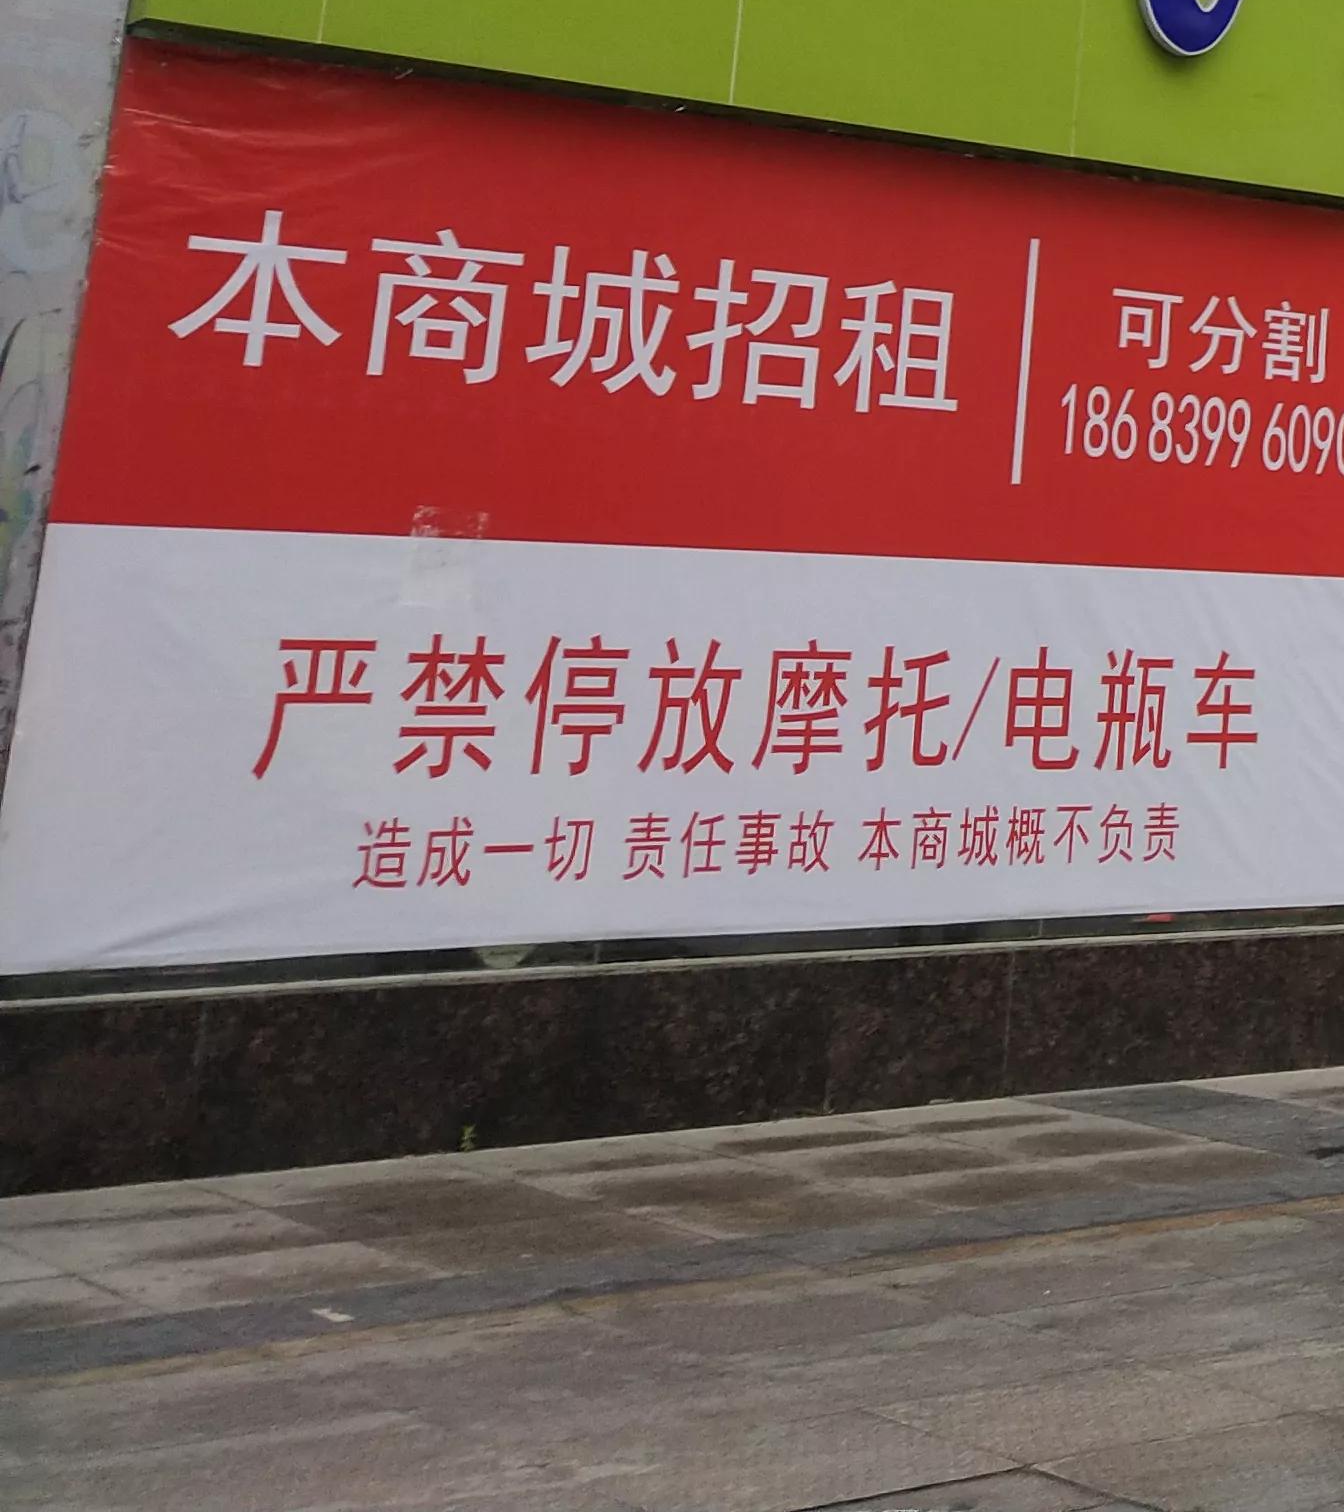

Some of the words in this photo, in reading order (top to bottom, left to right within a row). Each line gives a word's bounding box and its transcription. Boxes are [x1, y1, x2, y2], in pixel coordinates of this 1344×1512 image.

[168, 208, 961, 418] 本商城招租
[1111, 284, 1332, 386] 可分割
[250, 633, 1261, 782] 严禁停放摩托/电瓶车
[352, 816, 597, 893] 造成一切
[622, 808, 834, 880] 责任事故
[856, 802, 1182, 872] 本商城概不负责
